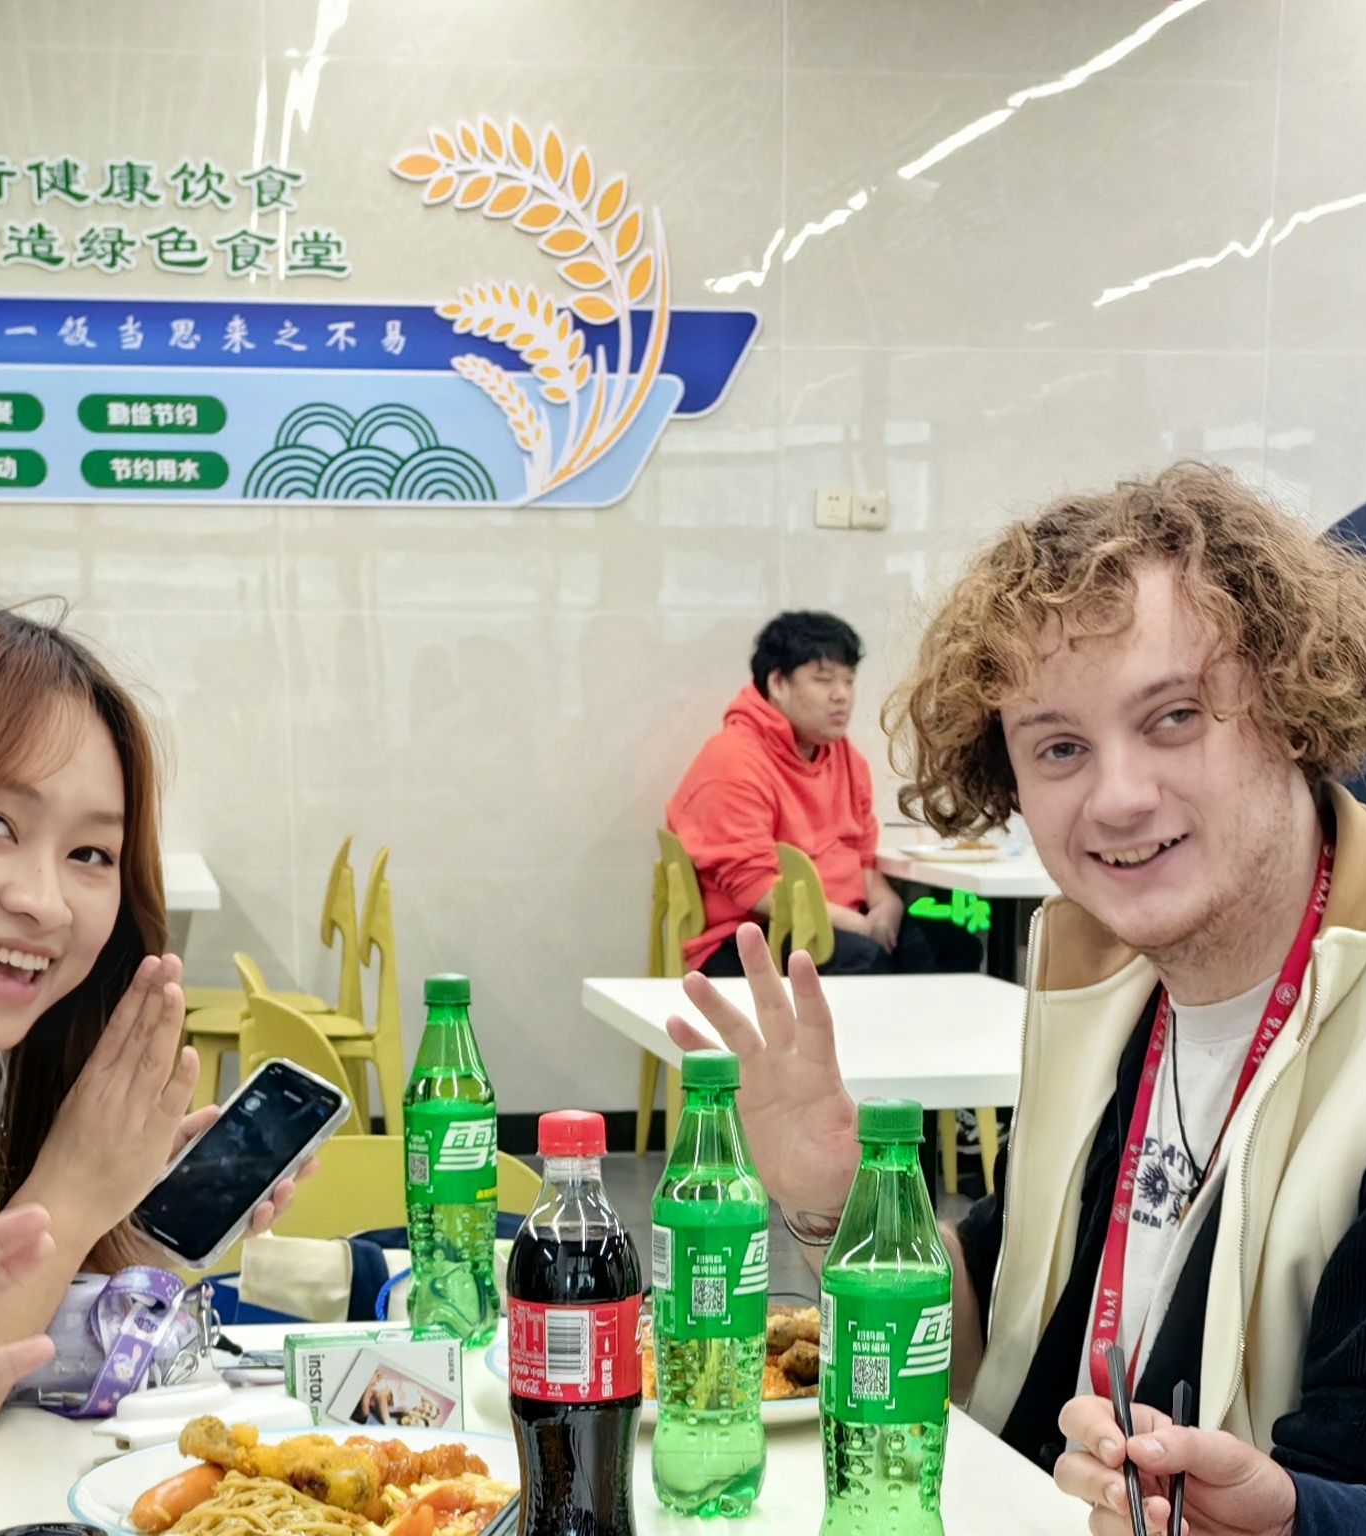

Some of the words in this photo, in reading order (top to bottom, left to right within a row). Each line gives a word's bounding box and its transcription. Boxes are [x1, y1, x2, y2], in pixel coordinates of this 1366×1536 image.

[107, 403, 198, 427] 勤俭节约
[110, 458, 200, 483] 节约用水
[309, 1354, 325, 1403] instax
